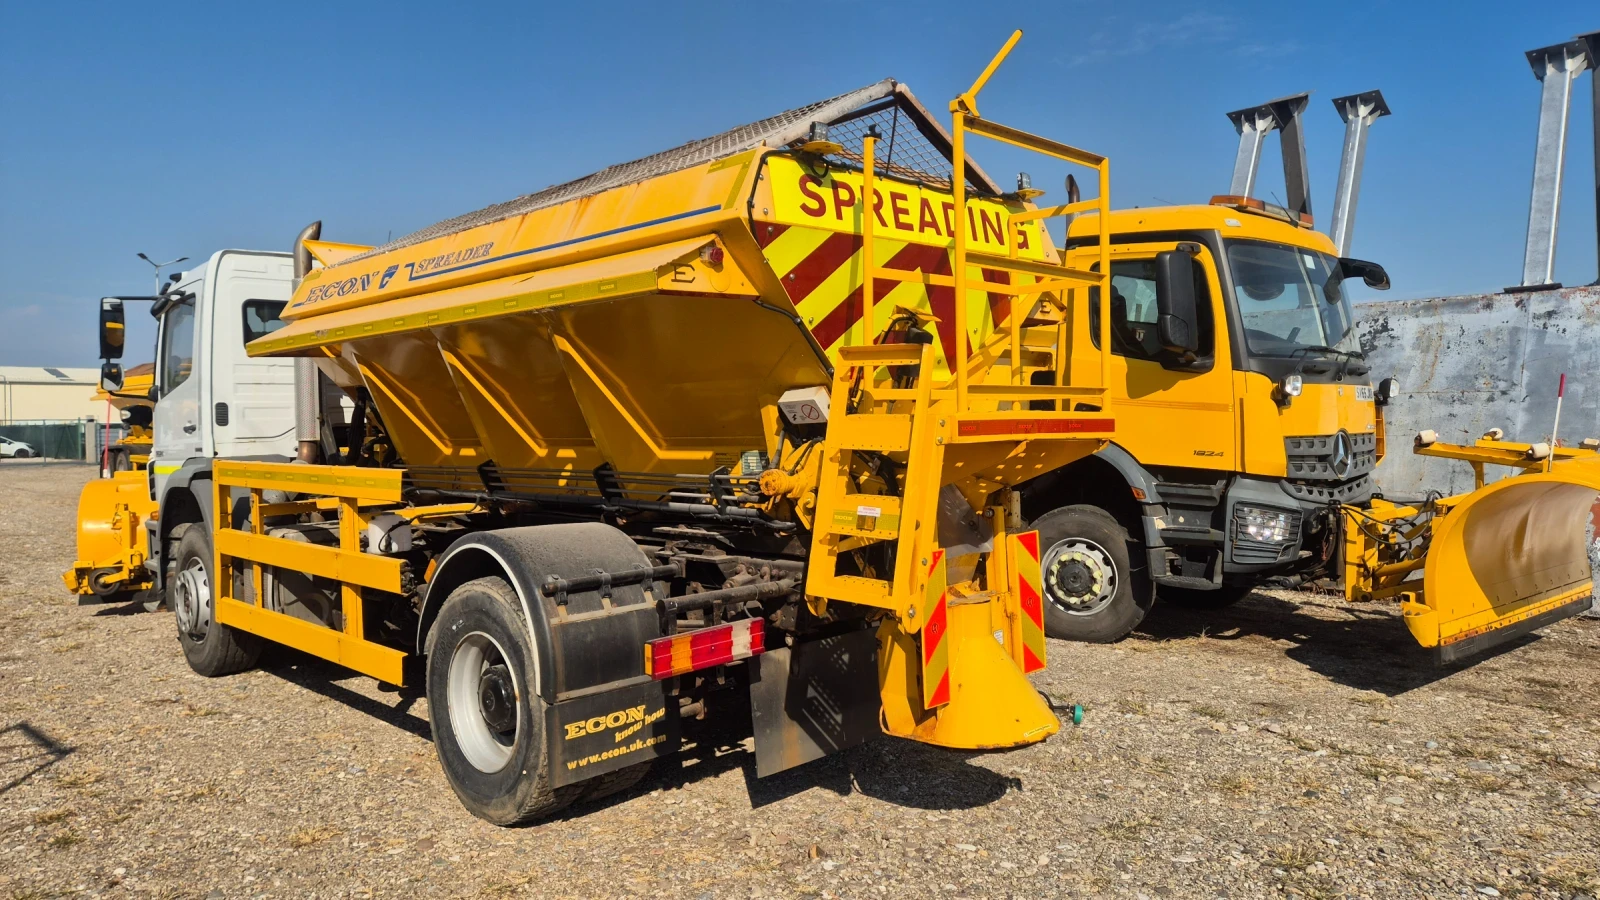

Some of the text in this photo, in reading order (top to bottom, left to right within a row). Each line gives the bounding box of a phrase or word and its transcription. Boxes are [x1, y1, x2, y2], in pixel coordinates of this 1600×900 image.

[415, 242, 494, 273] SPREADER
[303, 270, 380, 304] ECON
[1193, 449, 1224, 457] 1824
[564, 705, 646, 740] ECON
[614, 707, 666, 743] know how
[566, 734, 667, 770] www.econ.uk.com
